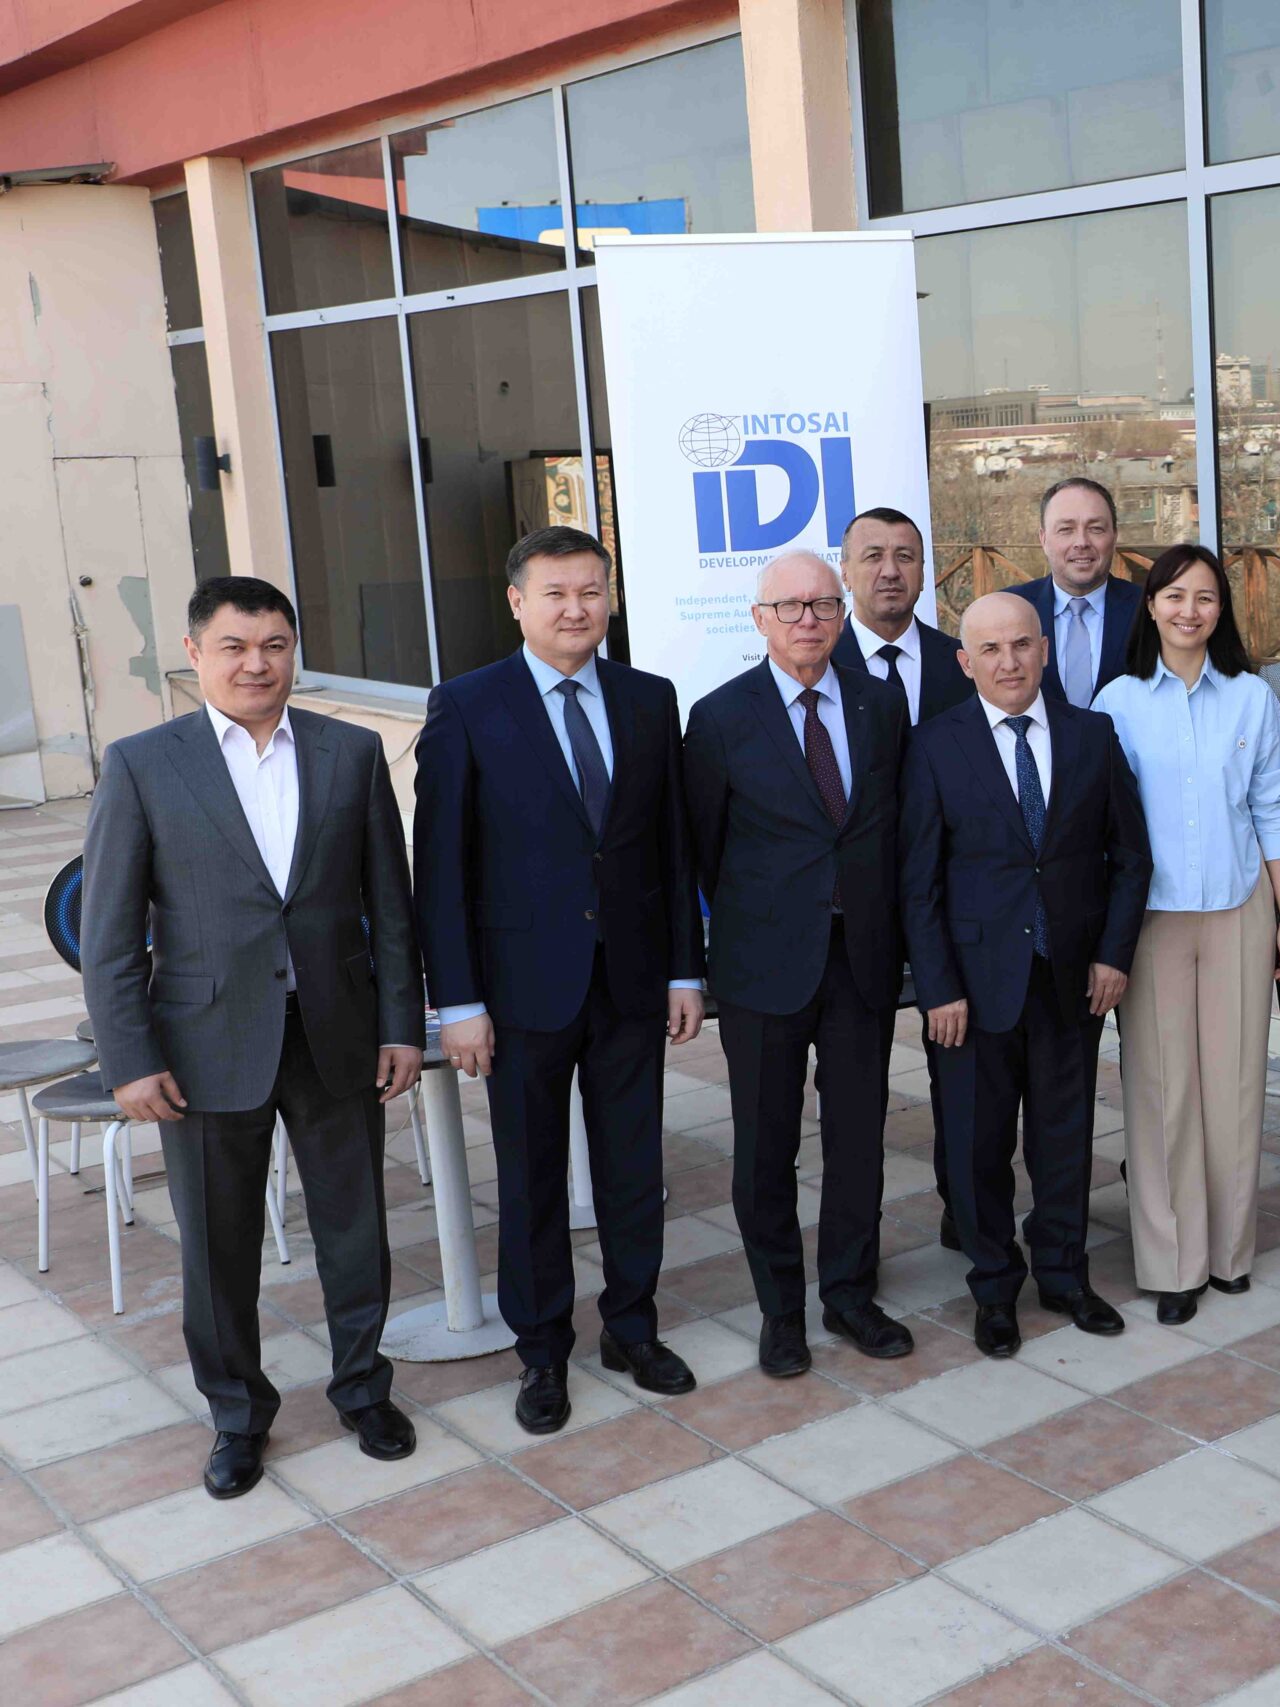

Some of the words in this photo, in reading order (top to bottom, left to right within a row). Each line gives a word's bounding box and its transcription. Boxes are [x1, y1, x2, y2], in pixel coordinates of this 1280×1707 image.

[743, 412, 849, 435] INTOSAI
[699, 555, 774, 569] DEVELOPM
[675, 594, 752, 607] Independent,
[680, 610, 731, 622] Supreme
[706, 623, 756, 634] societies
[742, 652, 761, 661] Visit
